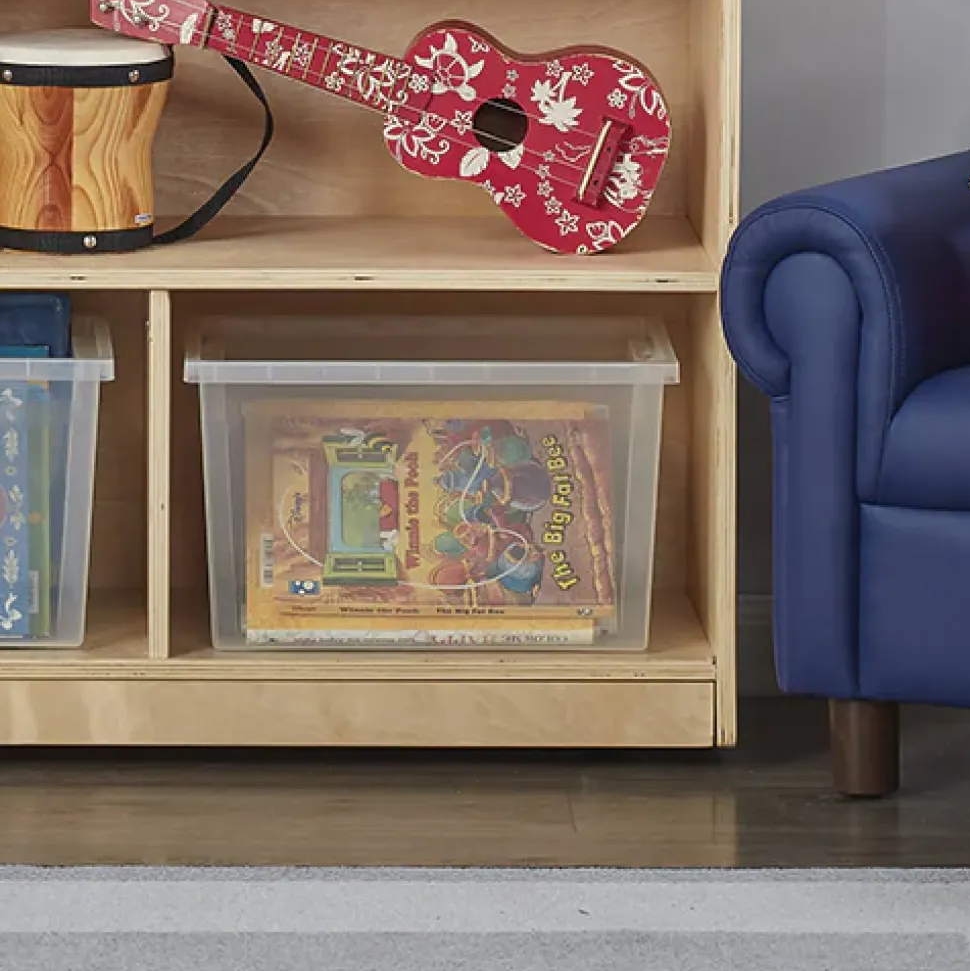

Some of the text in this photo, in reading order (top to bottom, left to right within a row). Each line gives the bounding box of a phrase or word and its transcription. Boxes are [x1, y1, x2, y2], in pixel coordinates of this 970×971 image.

[540, 434, 568, 473] Bee
[543, 510, 573, 545] Big
[550, 550, 580, 591] The
